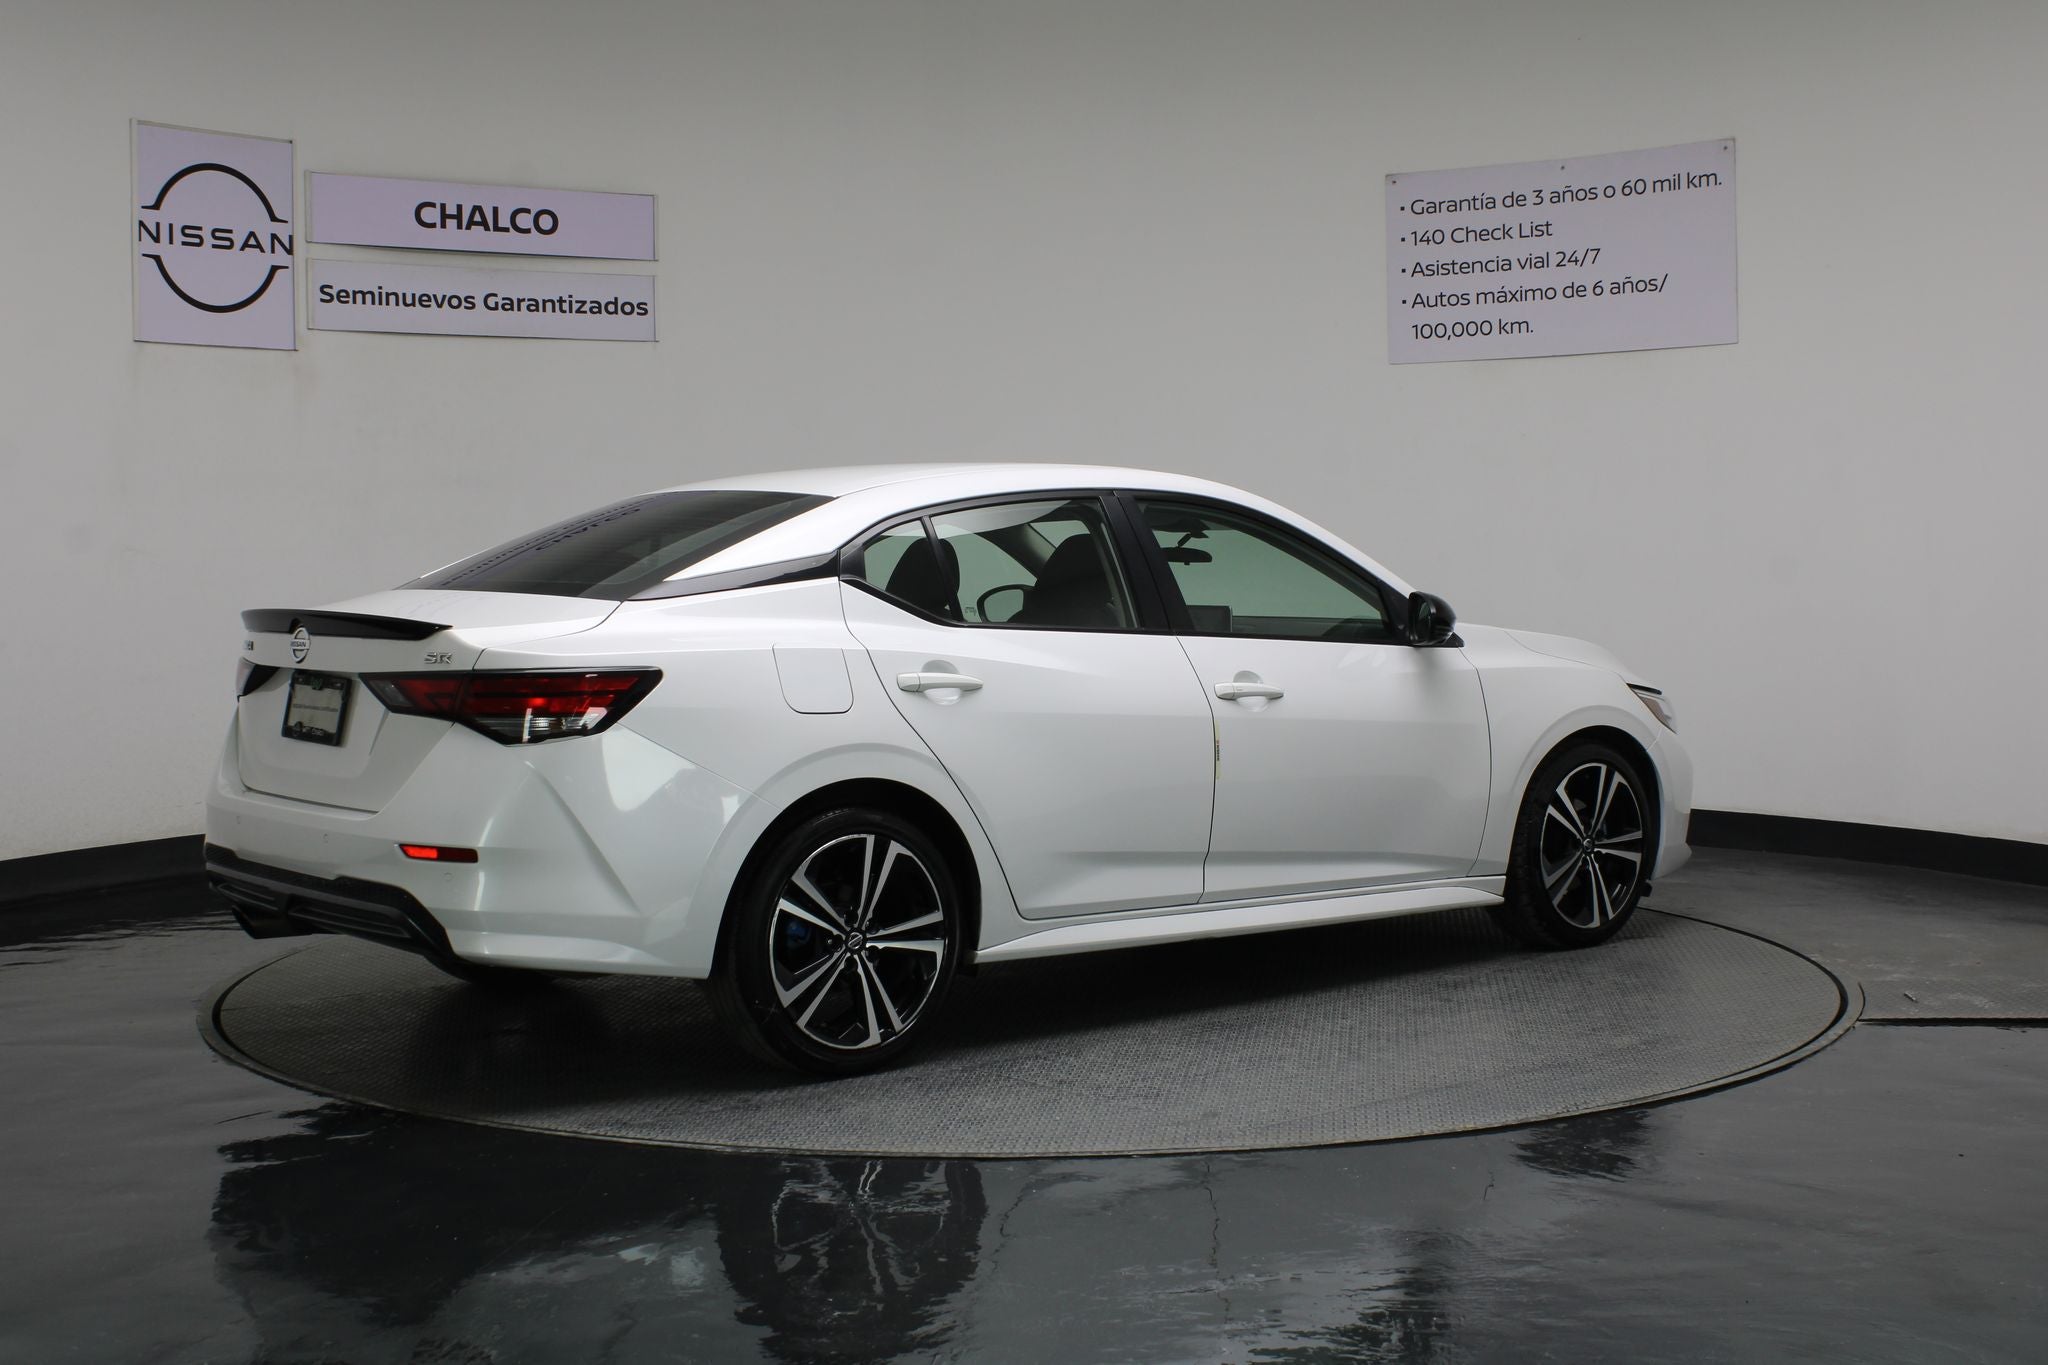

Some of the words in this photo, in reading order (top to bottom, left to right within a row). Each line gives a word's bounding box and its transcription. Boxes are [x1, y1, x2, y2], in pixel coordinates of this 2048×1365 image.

[1411, 193, 1496, 215] Garantía
[1502, 191, 1527, 208] de
[1533, 189, 1544, 205] 3
[1550, 185, 1598, 204] años
[1603, 185, 1616, 198] o
[1621, 179, 1646, 196] 60
[1653, 173, 1680, 193] mil
[1687, 172, 1722, 189] km.
[414, 202, 559, 235] CHALCO
[1411, 229, 1445, 246] 140
[1451, 224, 1513, 243] Check
[1519, 221, 1552, 238] List
[138, 220, 293, 255] NISSAN
[1411, 256, 1511, 277] Asistencia
[1517, 252, 1549, 270] vial
[1556, 248, 1600, 267] 24/7
[320, 284, 476, 310] Seminuevos
[483, 293, 648, 316] Garantizados
[1412, 292, 1470, 309] Autos
[1476, 286, 1557, 304] máximo
[1563, 282, 1587, 298] de
[1593, 280, 1604, 296] 6
[1610, 274, 1668, 295] años/
[1412, 320, 1492, 340] 100,000
[1499, 319, 1533, 334] km.
[424, 652, 452, 665] SR
